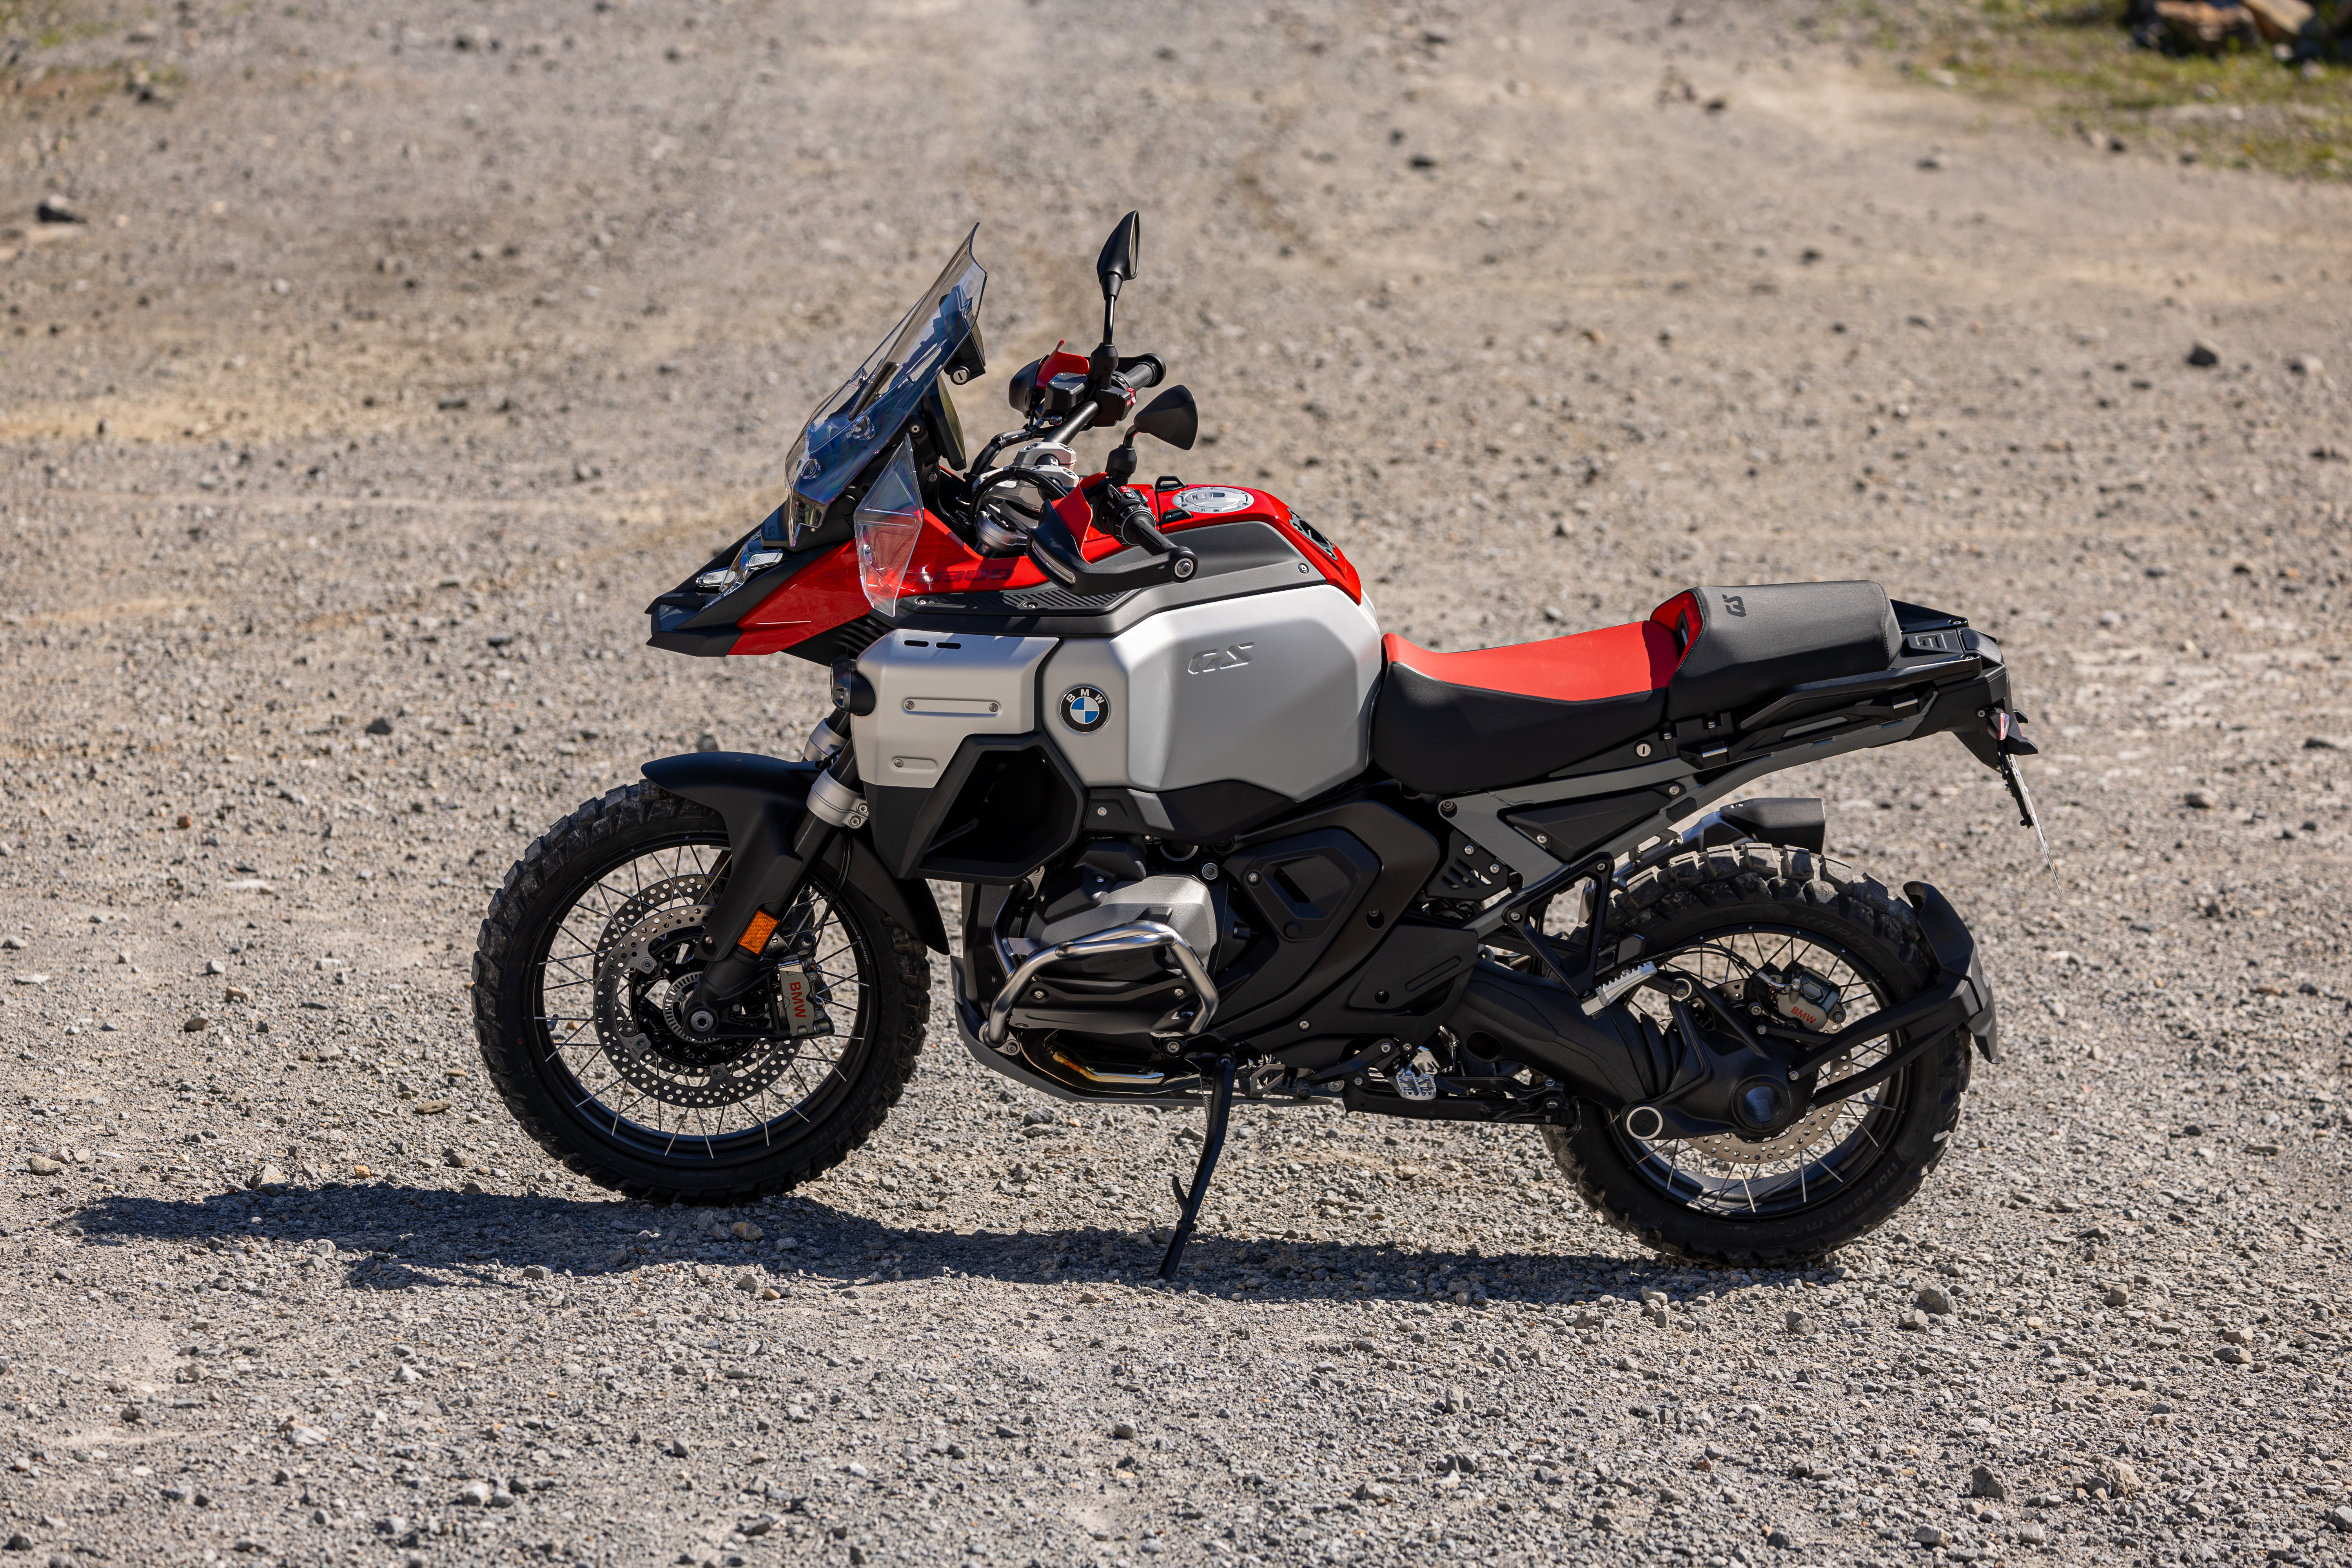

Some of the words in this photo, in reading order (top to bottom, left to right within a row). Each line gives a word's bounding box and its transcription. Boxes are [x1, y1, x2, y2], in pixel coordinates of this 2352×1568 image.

[768, 525, 776, 537] GS
[1722, 594, 1747, 617] GS
[1188, 641, 1255, 675] GS
[1066, 689, 1105, 704] BMW
[1795, 913, 1882, 959] KAROO
[1088, 958, 1118, 968] SHIFT
[1123, 952, 1147, 962] CAM
[789, 982, 807, 1018] BMW
[1791, 1006, 1817, 1024] BMW
[840, 1042, 889, 1122] 120/70R19
[806, 1122, 841, 1151] M/C
[1827, 1162, 1900, 1223] 170/60R17
[1785, 1219, 1826, 1237] M/C
